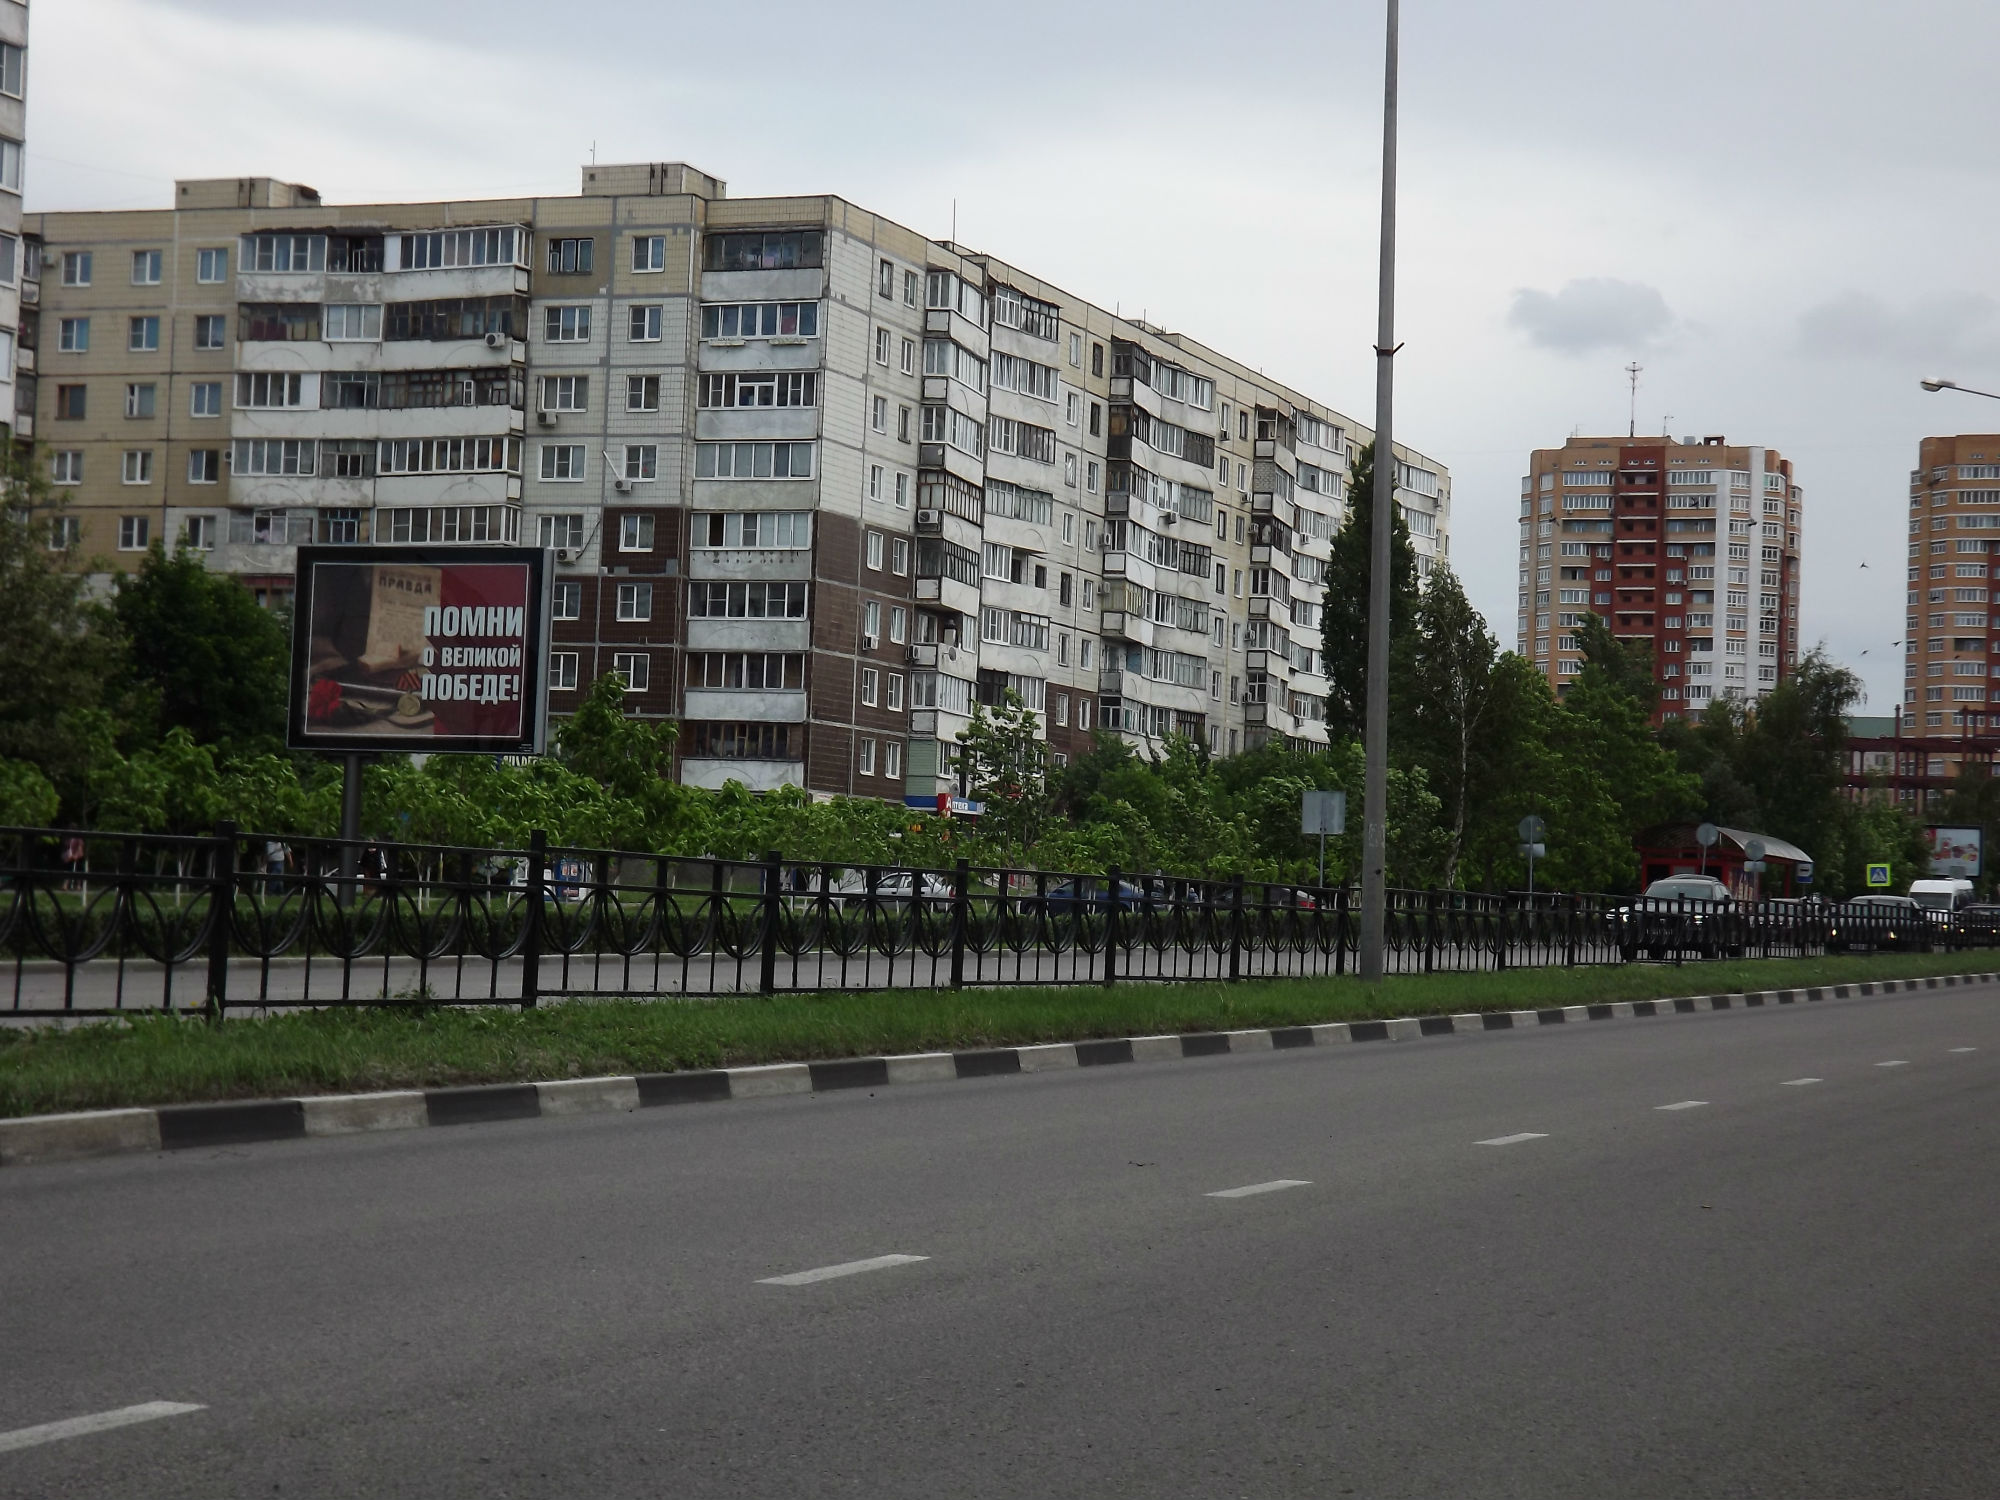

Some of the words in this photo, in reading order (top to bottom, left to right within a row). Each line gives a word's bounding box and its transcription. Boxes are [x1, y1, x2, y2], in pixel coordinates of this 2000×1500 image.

[379, 576, 432, 595] ПРАВДА
[424, 606, 524, 637] ПОМНИ
[423, 646, 435, 667] О
[441, 643, 521, 668] ВЕЛИКОЙ
[421, 673, 520, 705] ПОБЕДЕ!
